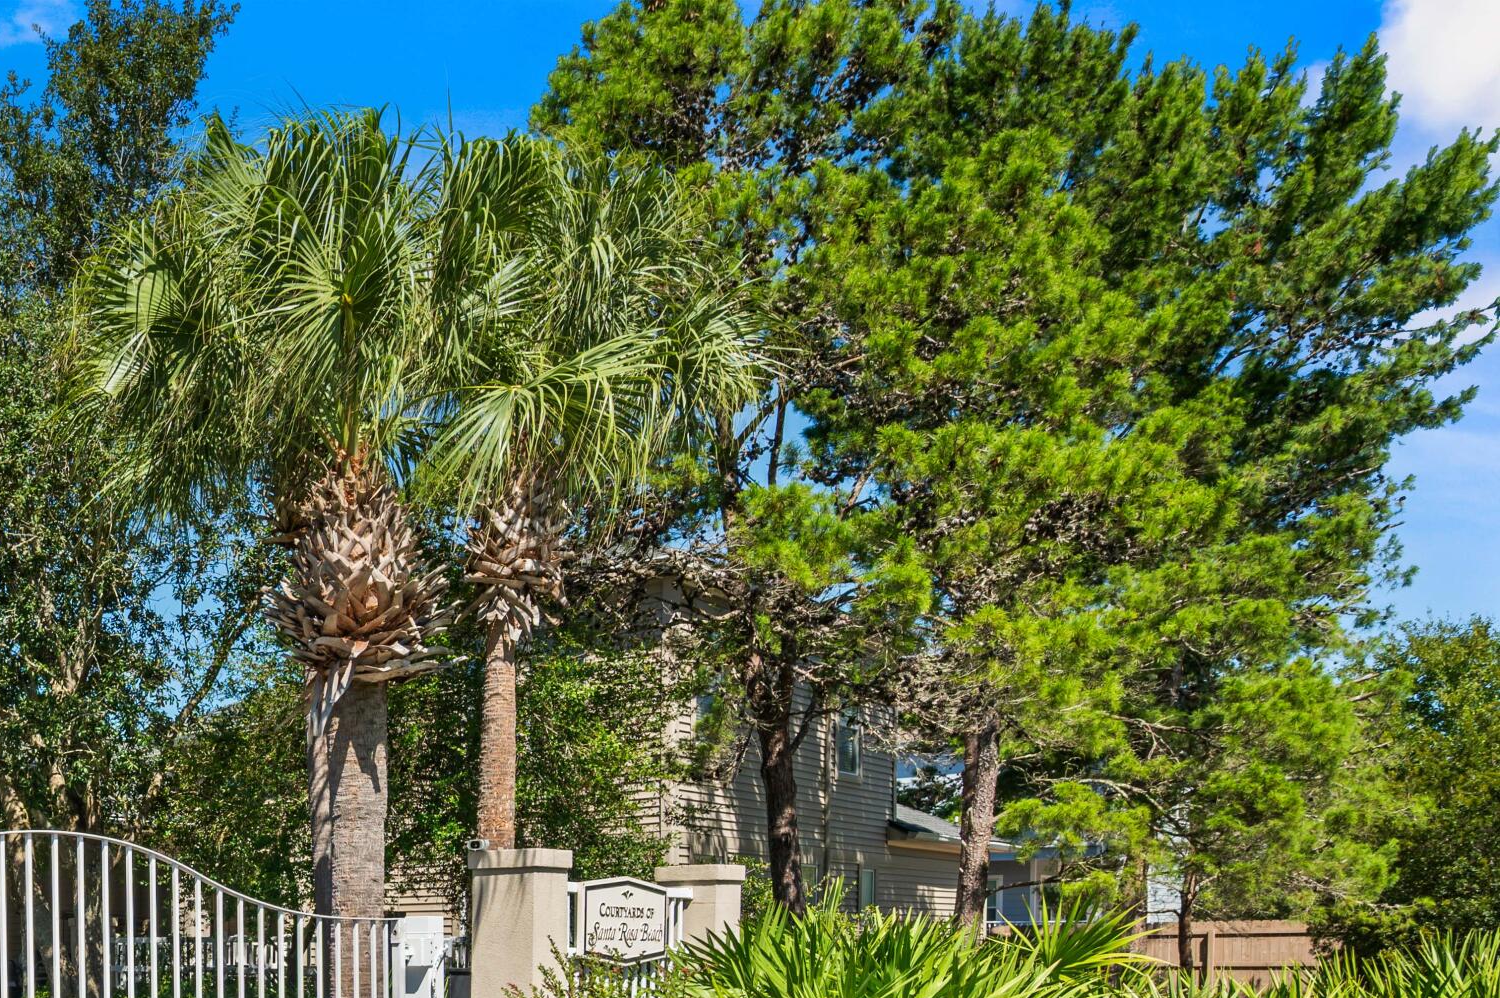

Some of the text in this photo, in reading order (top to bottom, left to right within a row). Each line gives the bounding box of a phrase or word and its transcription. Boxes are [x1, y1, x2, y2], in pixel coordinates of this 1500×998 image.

[599, 902, 655, 919] COURTYARDS OF
[588, 921, 663, 948] Santa Rosa Beach
